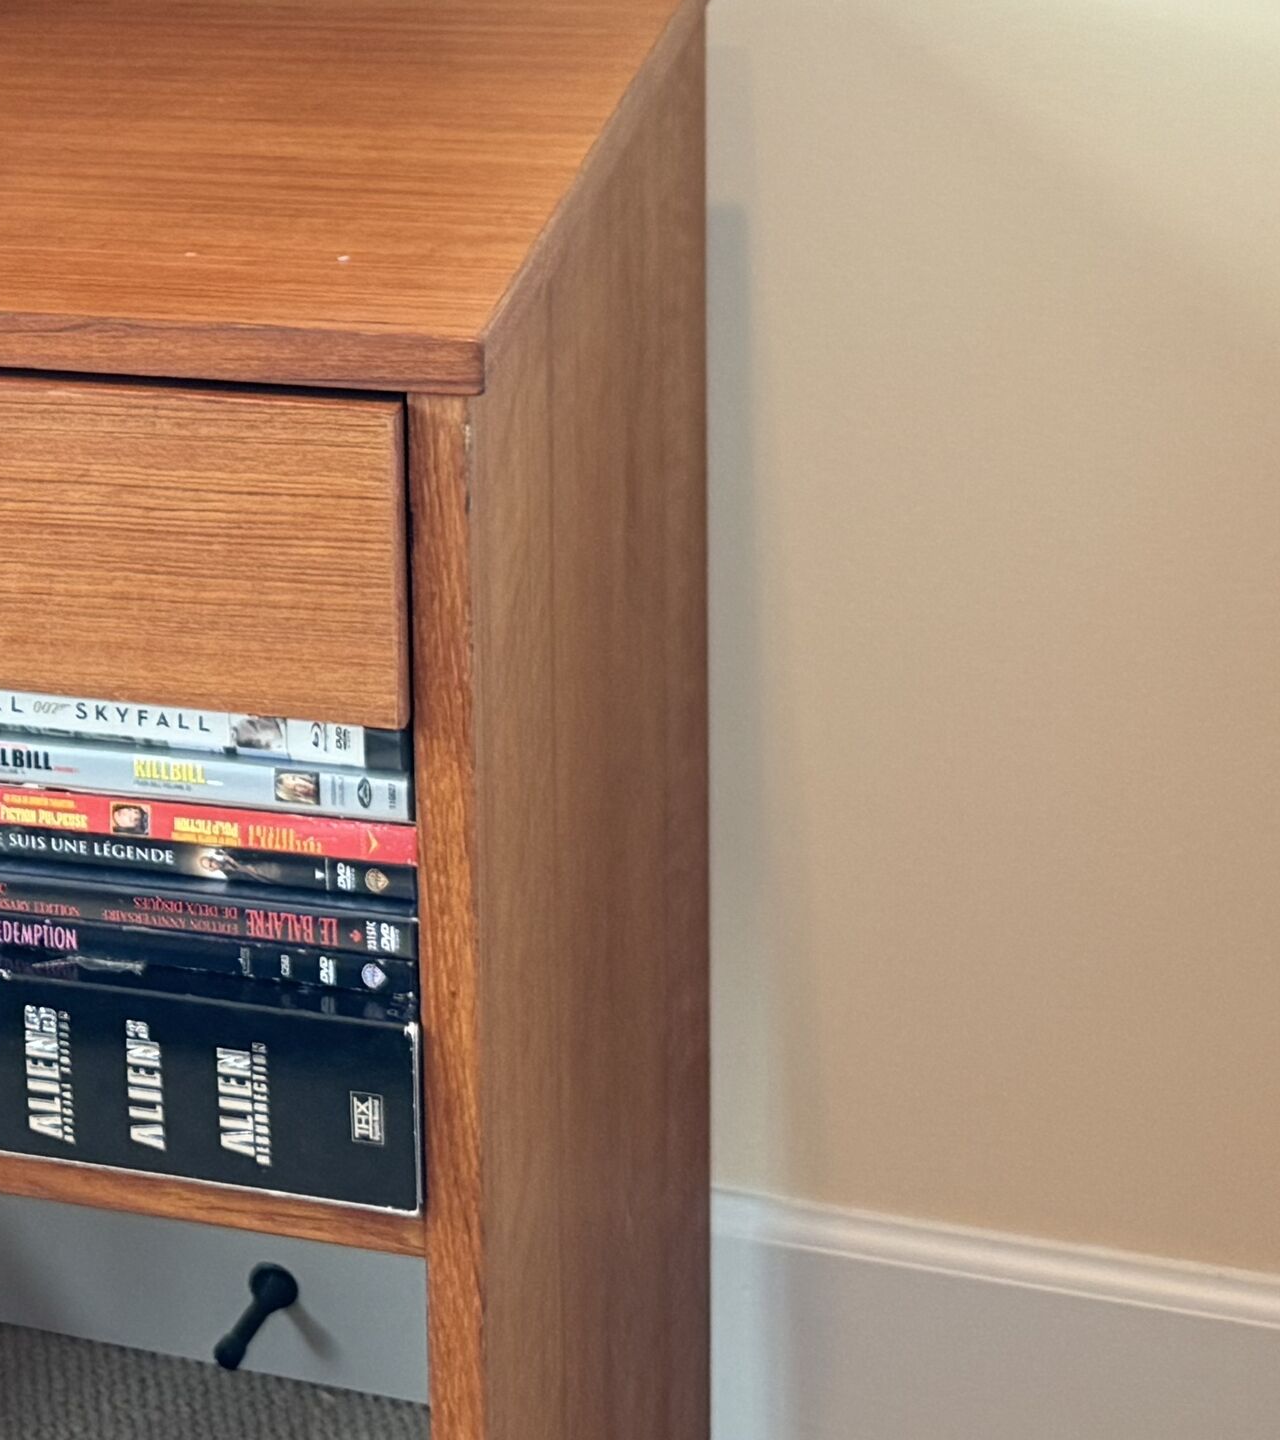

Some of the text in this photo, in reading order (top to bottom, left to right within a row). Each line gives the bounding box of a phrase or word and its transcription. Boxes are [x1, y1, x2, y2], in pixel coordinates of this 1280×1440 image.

[76, 702, 210, 733] SKYFALL
[11, 748, 53, 771] BILL
[134, 759, 206, 785] KILL BILL
[9, 833, 47, 850] SUIS
[51, 837, 88, 856] UNE
[93, 840, 175, 865] LÉGENDE
[337, 862, 348, 889] DVD
[34, 901, 81, 917] EDITION
[102, 909, 186, 930] ANNIVERSAIRE
[132, 896, 238, 919] DE DEUX DISQUES
[318, 917, 338, 946] LE
[381, 923, 392, 951] DVD
[319, 956, 331, 984] DVD
[24, 1004, 64, 1140] ALIENS
[216, 1046, 257, 1158] ALIEN
[251, 1041, 273, 1167] RESURRECTION
[353, 1095, 372, 1139] THX
